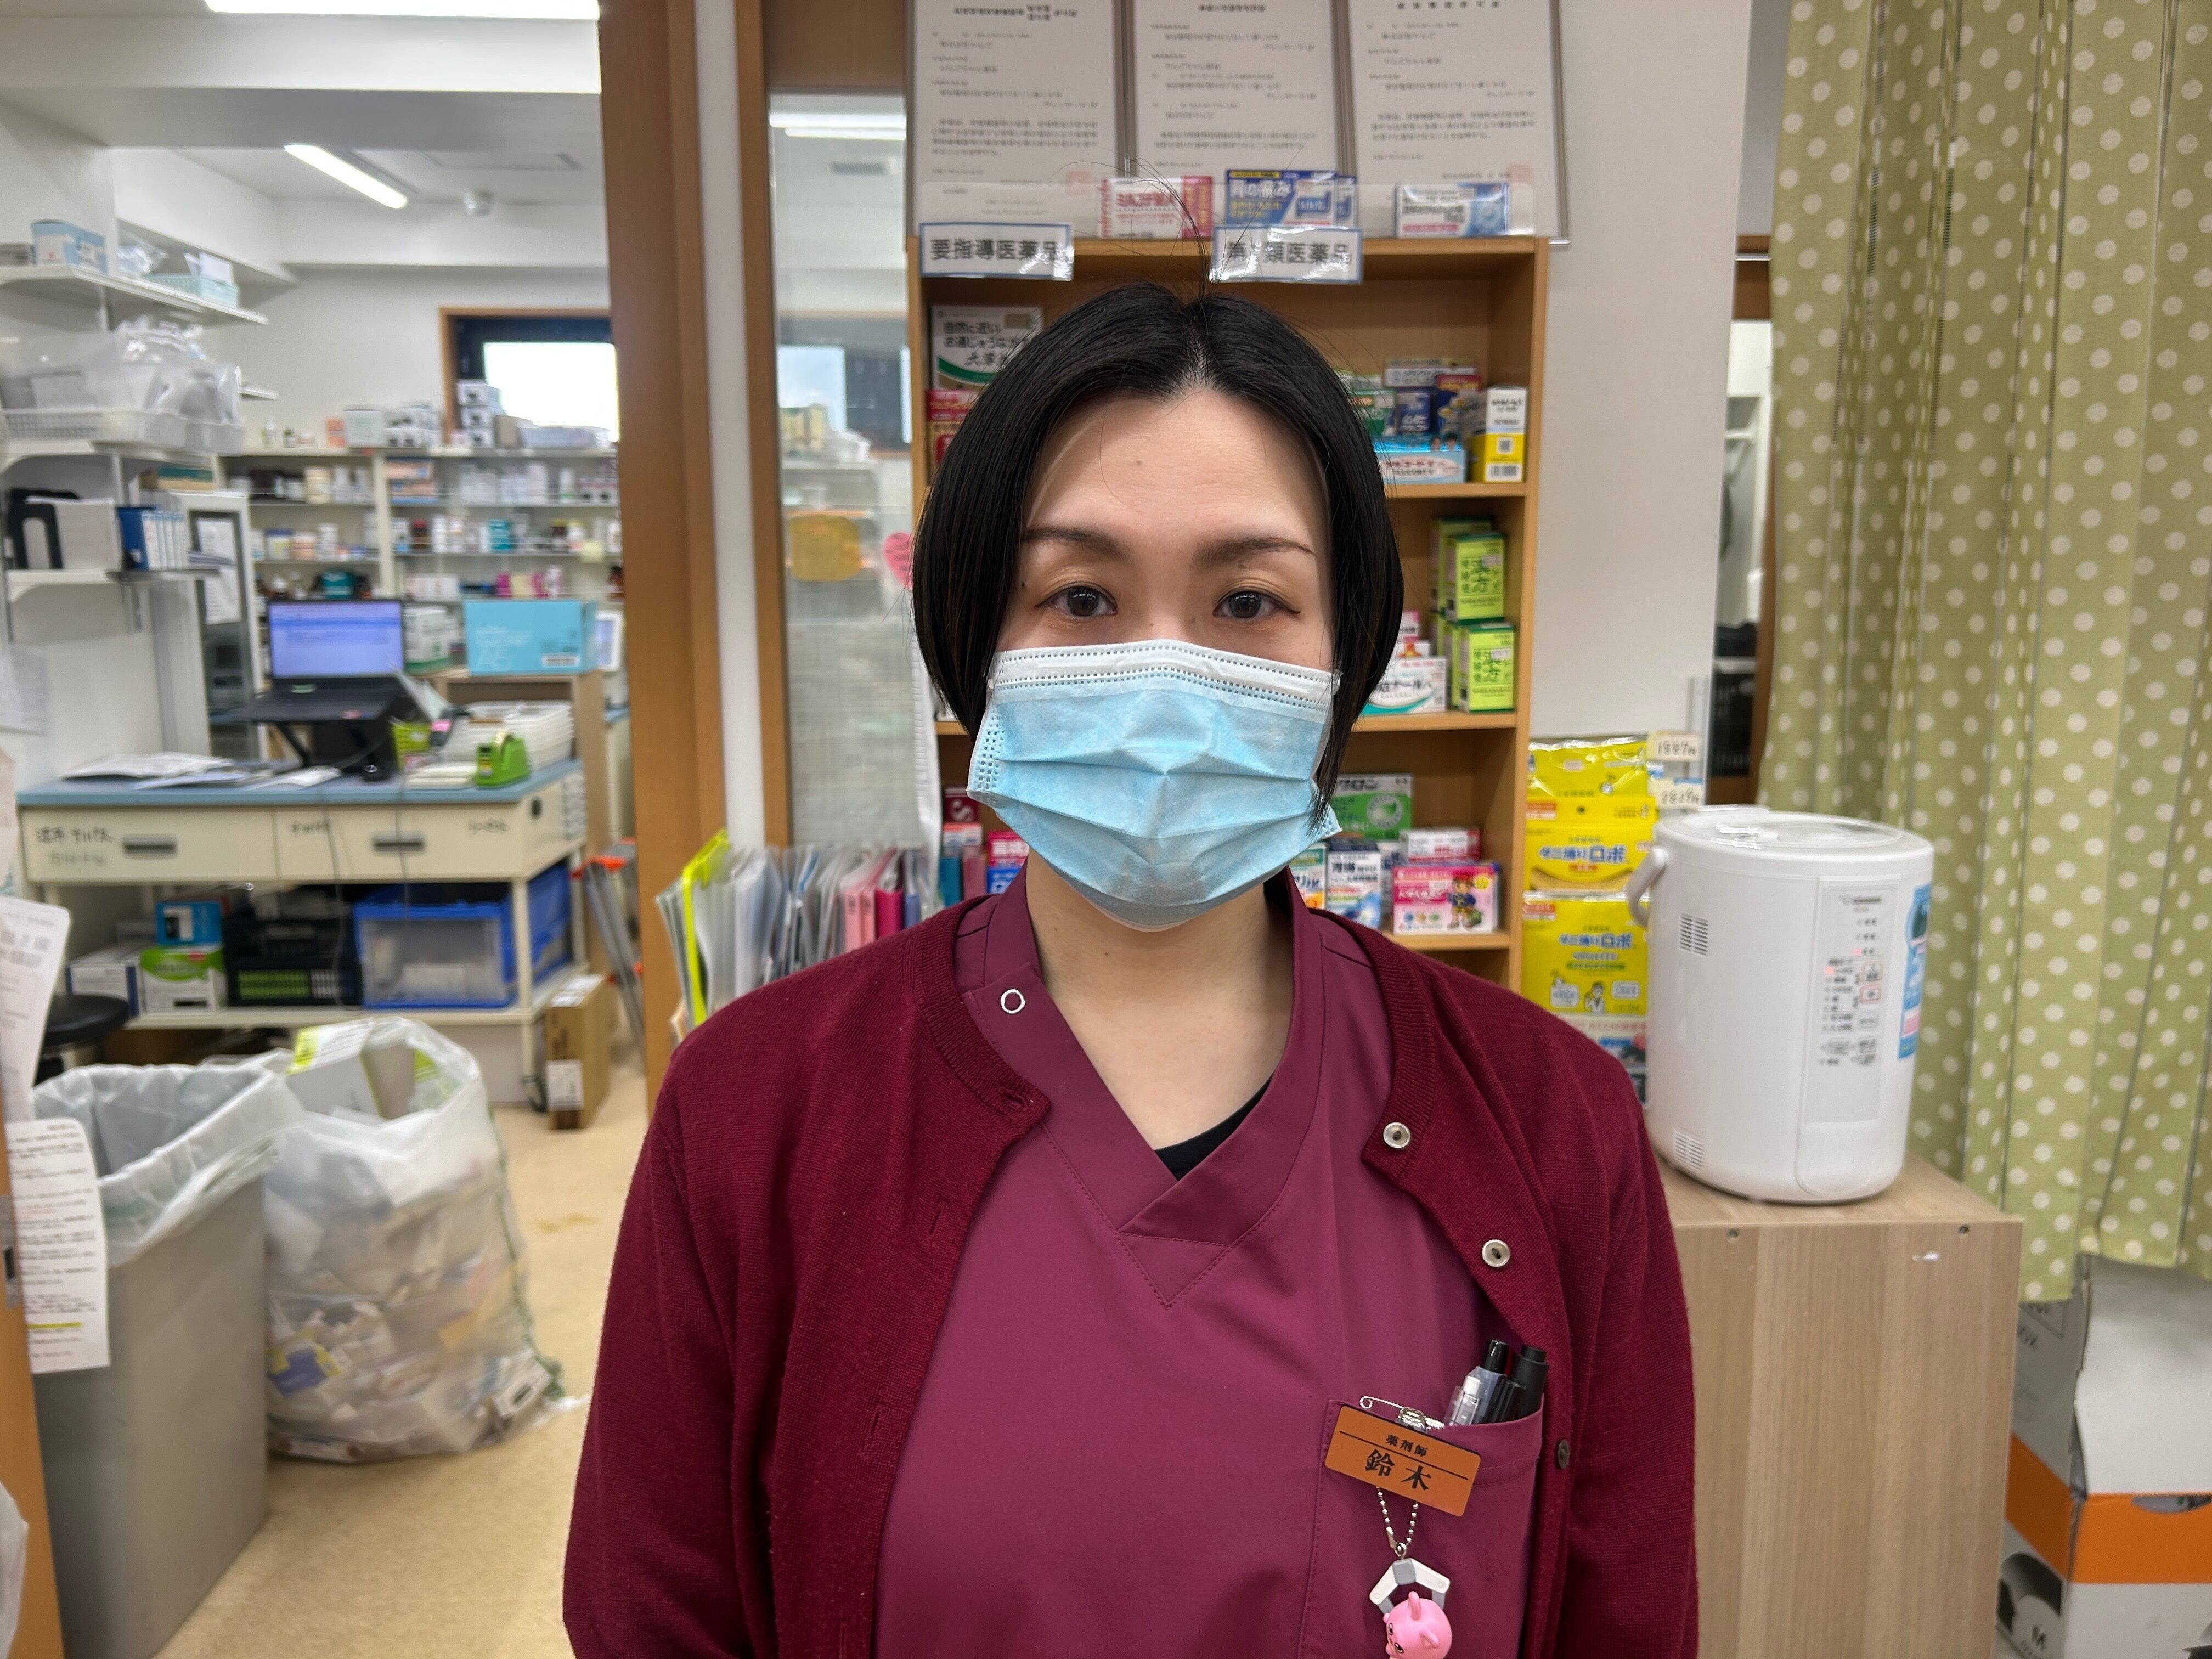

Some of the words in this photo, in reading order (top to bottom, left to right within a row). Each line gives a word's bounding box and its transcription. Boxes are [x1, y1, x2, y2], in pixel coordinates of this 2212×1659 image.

[1227, 241, 1351, 264] 第類医薬品
[1386, 1434, 1428, 1457] 薬剤師
[1364, 1449, 1431, 1491] 鈴木
